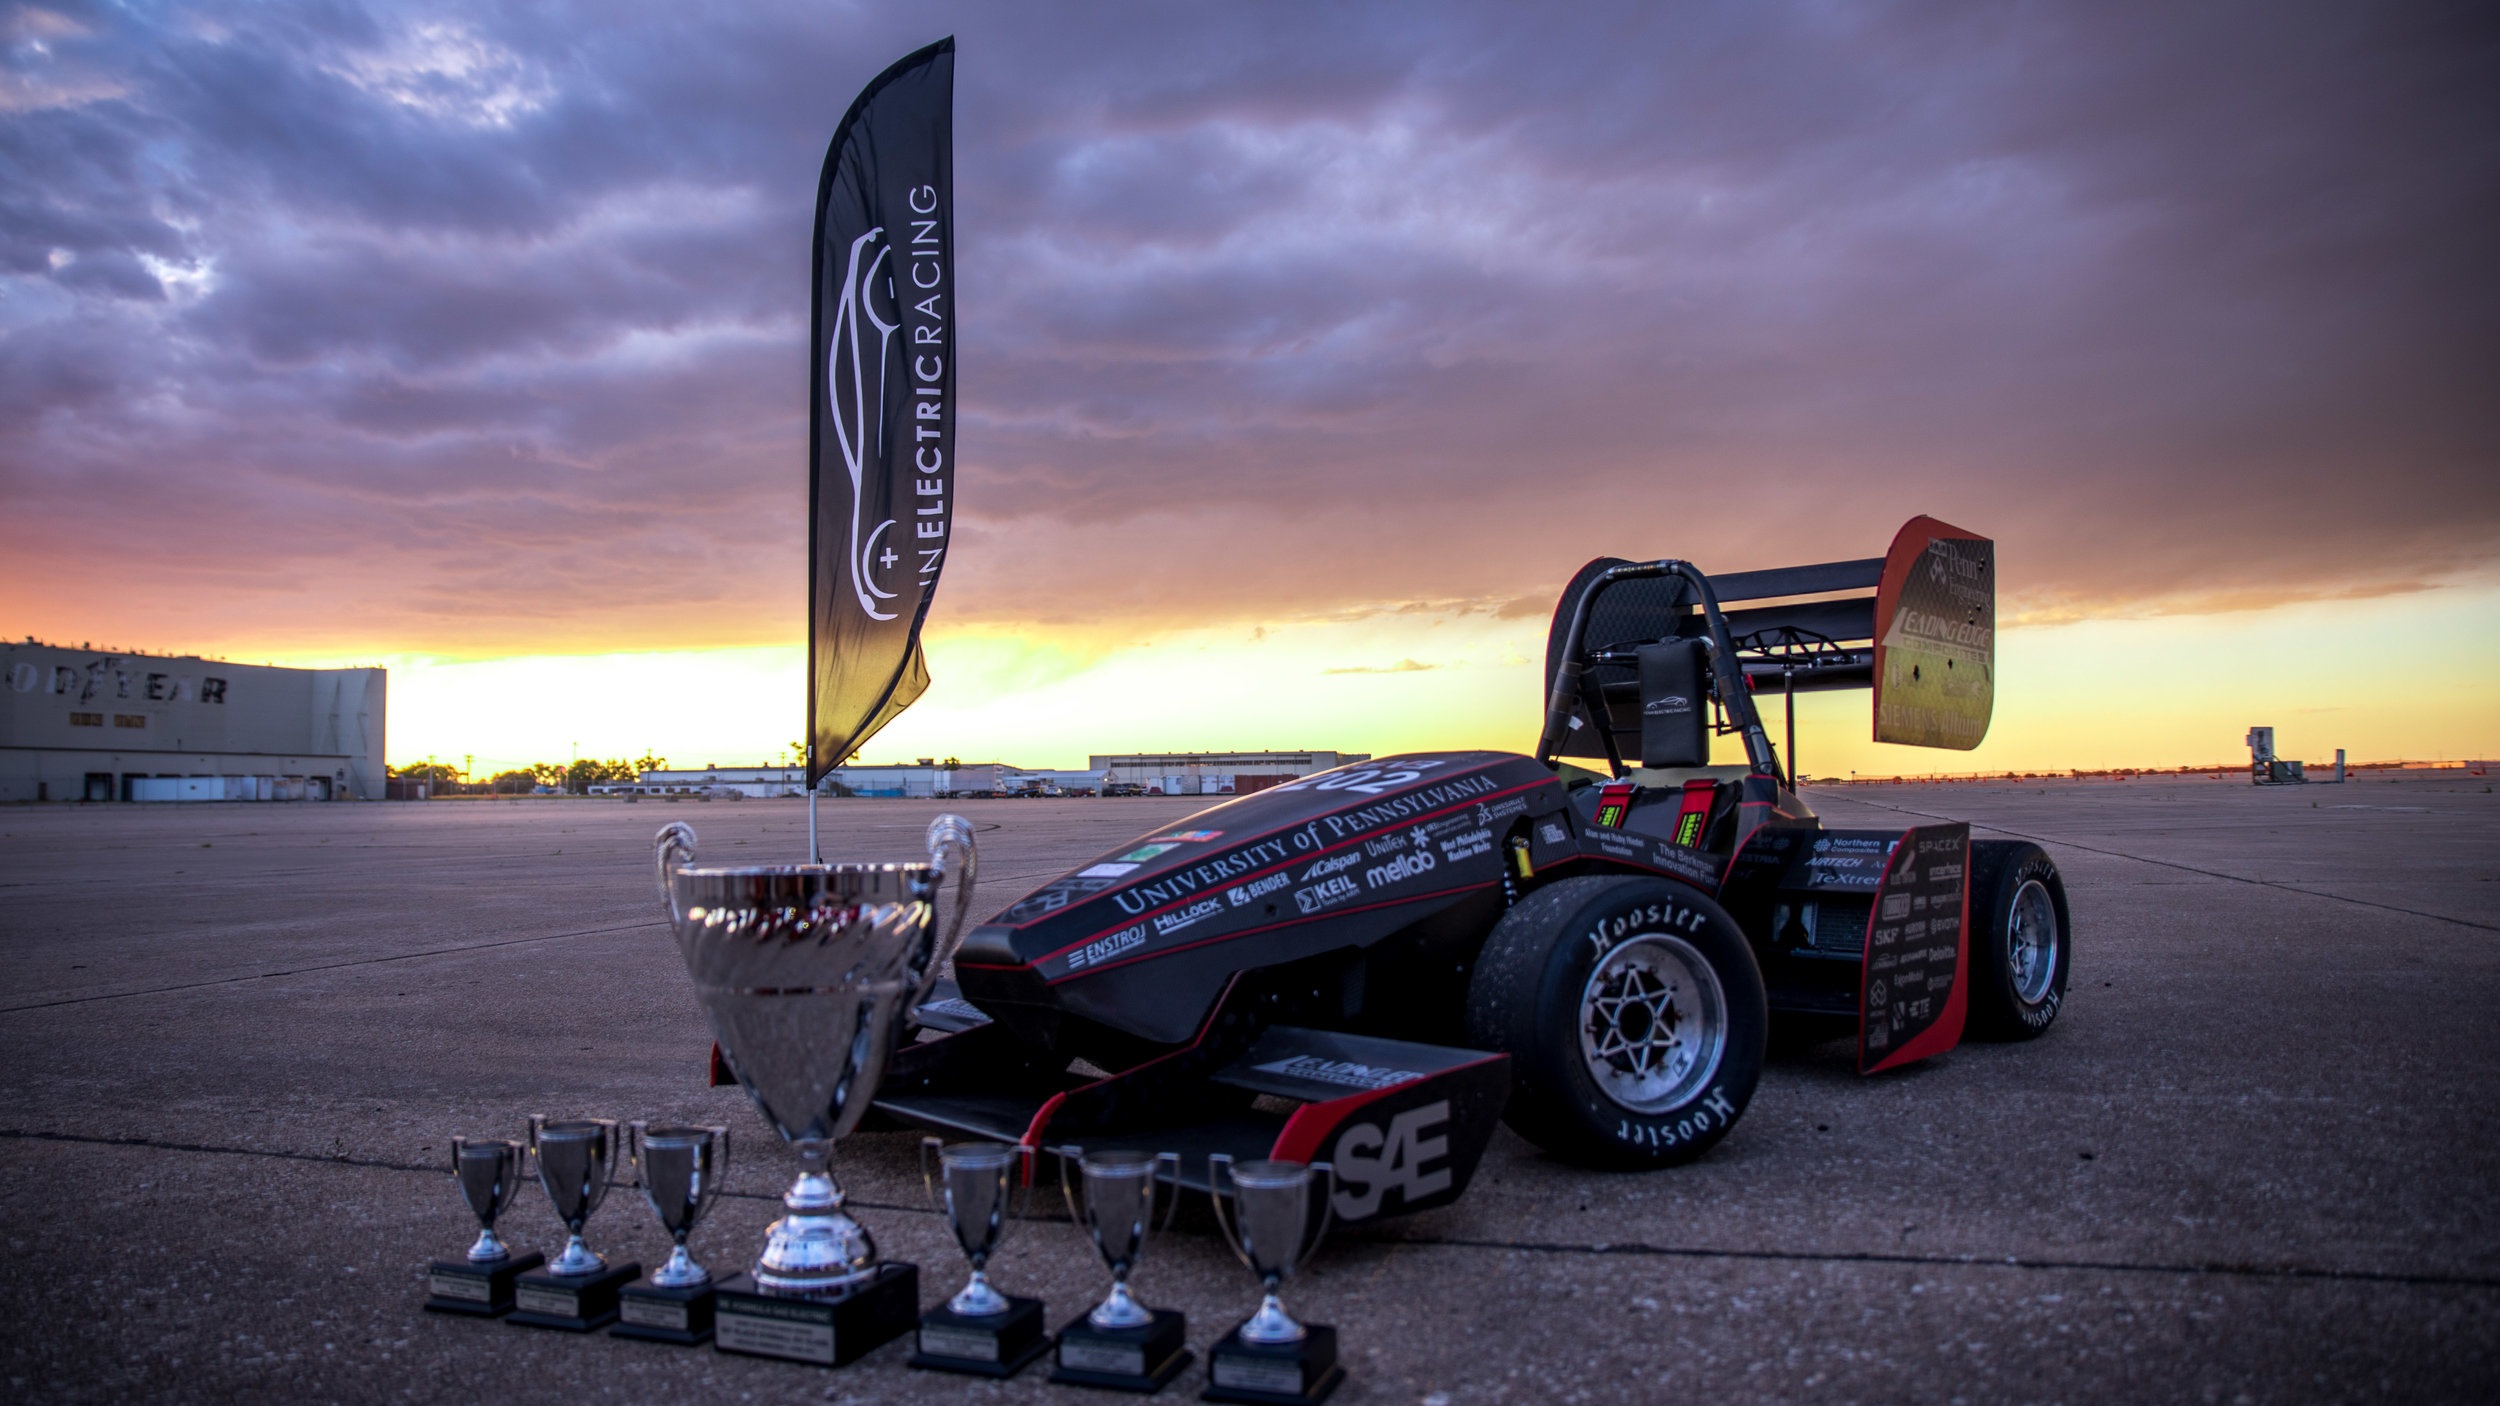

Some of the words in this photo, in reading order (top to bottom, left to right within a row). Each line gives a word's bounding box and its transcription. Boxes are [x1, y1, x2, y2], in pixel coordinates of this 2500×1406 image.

[908, 184, 943, 344] RACING
[1880, 702, 1939, 732] SIEMENS
[1294, 821, 1324, 850] of
[1833, 838, 1881, 848] Northern
[1316, 851, 1361, 876] Calspan
[1652, 851, 1699, 880] Innovation
[1658, 842, 1676, 859] The
[1677, 849, 1715, 873] Berkman
[1804, 856, 1864, 868] AIRTECH
[1247, 871, 1292, 899] BENDER
[1315, 875, 1358, 900] KEIL
[1874, 926, 1900, 947] SKF
[1332, 1099, 1452, 1222] SAE
